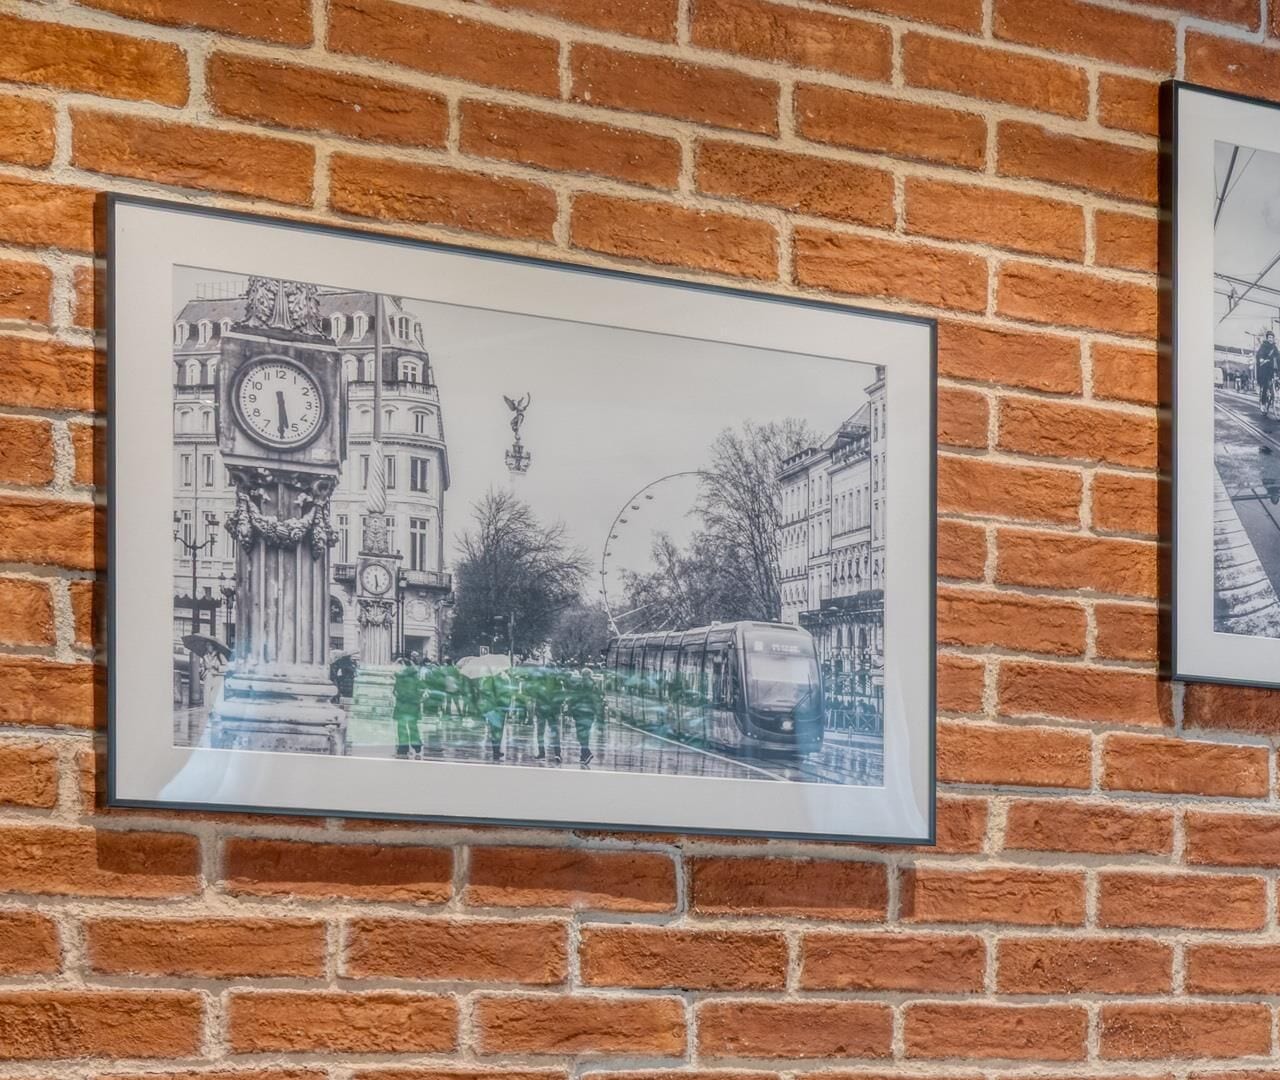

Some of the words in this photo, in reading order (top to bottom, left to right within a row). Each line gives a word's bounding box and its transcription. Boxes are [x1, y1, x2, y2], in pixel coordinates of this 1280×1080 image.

[264, 372, 270, 380] 11
[276, 370, 287, 379] 12
[293, 376, 296, 384] 1
[252, 381, 263, 390] 10
[301, 387, 309, 396] 2
[248, 394, 257, 403] 9
[305, 401, 312, 410] 3
[253, 408, 261, 417] 8
[300, 414, 308, 422] 4
[264, 419, 271, 428] 7
[291, 423, 298, 432] 5
